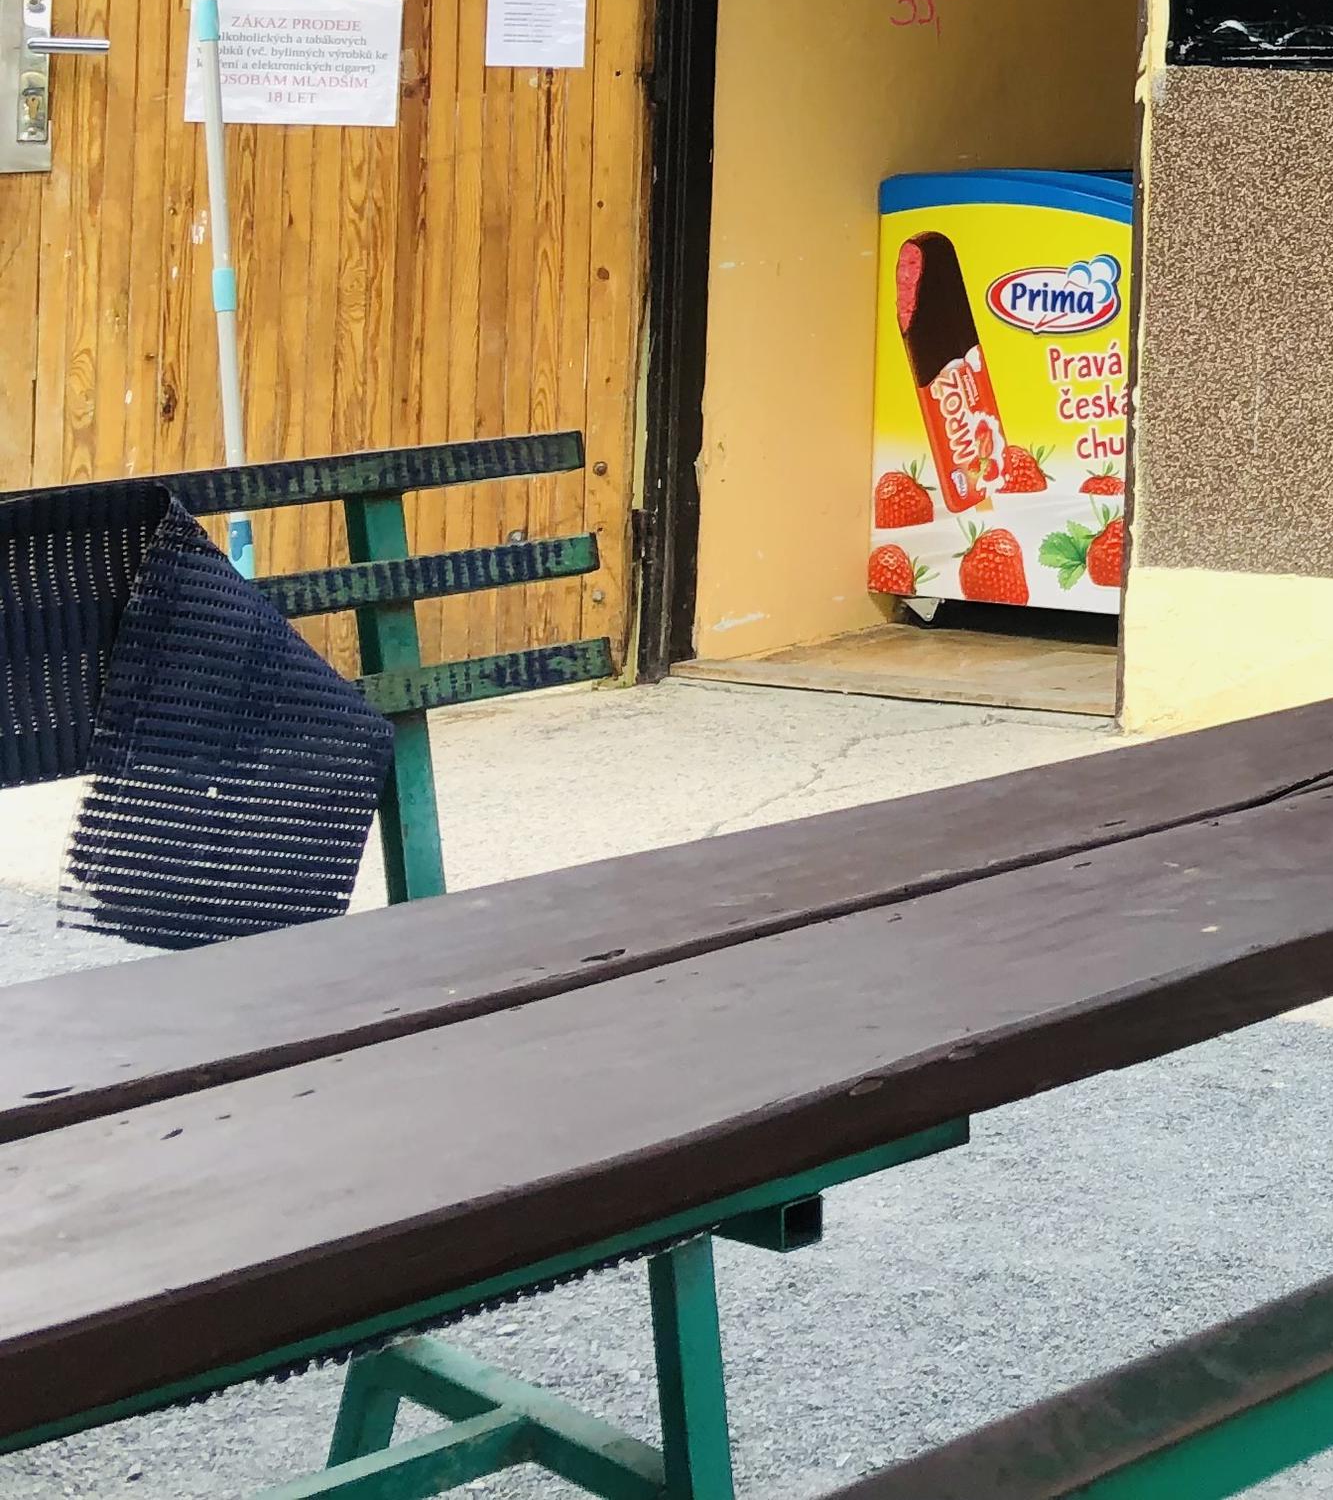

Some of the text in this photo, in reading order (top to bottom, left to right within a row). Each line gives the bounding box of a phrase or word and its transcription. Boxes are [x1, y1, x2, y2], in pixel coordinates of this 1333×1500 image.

[231, 16, 362, 32] ZÁKAZ PRODEJE
[375, 51, 389, 61] ke
[292, 74, 369, 88] MLADŠÍM
[267, 91, 318, 104] 18 LET
[1010, 282, 1094, 314] Prima
[1050, 342, 1122, 380] Pravá
